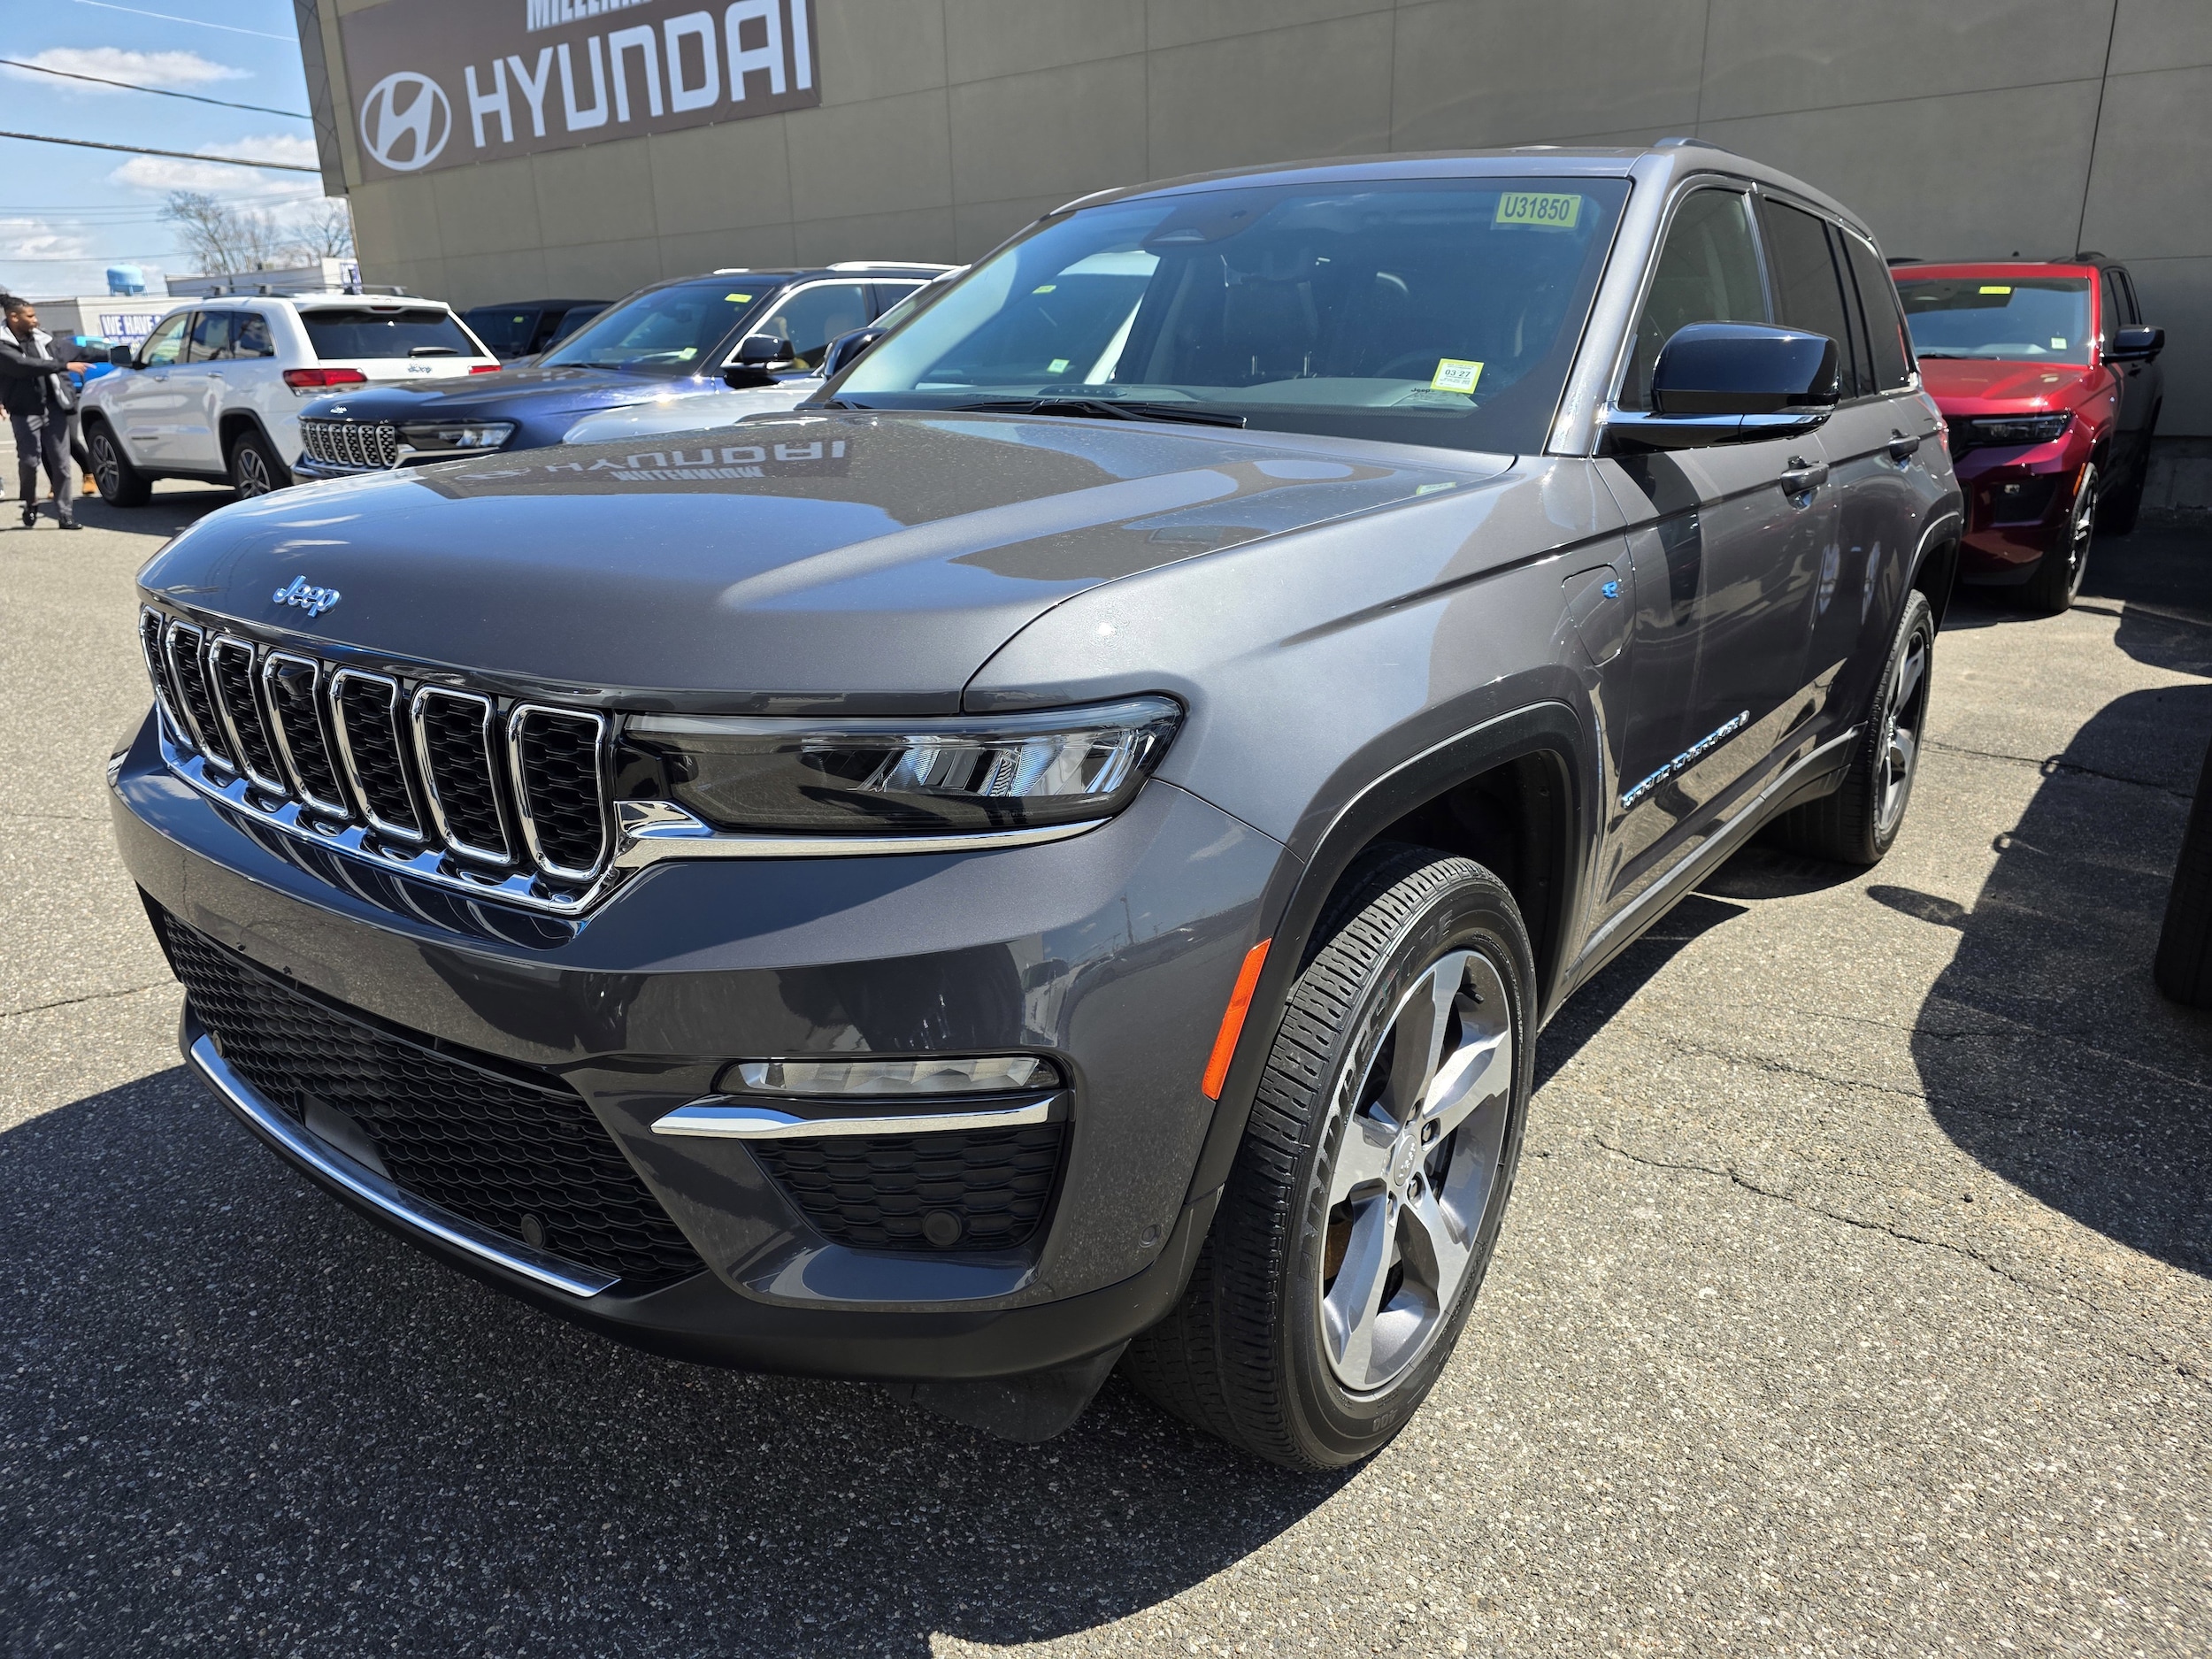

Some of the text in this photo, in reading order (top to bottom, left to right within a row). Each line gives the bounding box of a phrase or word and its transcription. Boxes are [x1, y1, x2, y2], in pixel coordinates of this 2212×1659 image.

[464, 0, 813, 149] HYUNDAI
[1503, 196, 1571, 221] U31850
[101, 315, 124, 336] WE
[272, 574, 341, 618] Jeep
